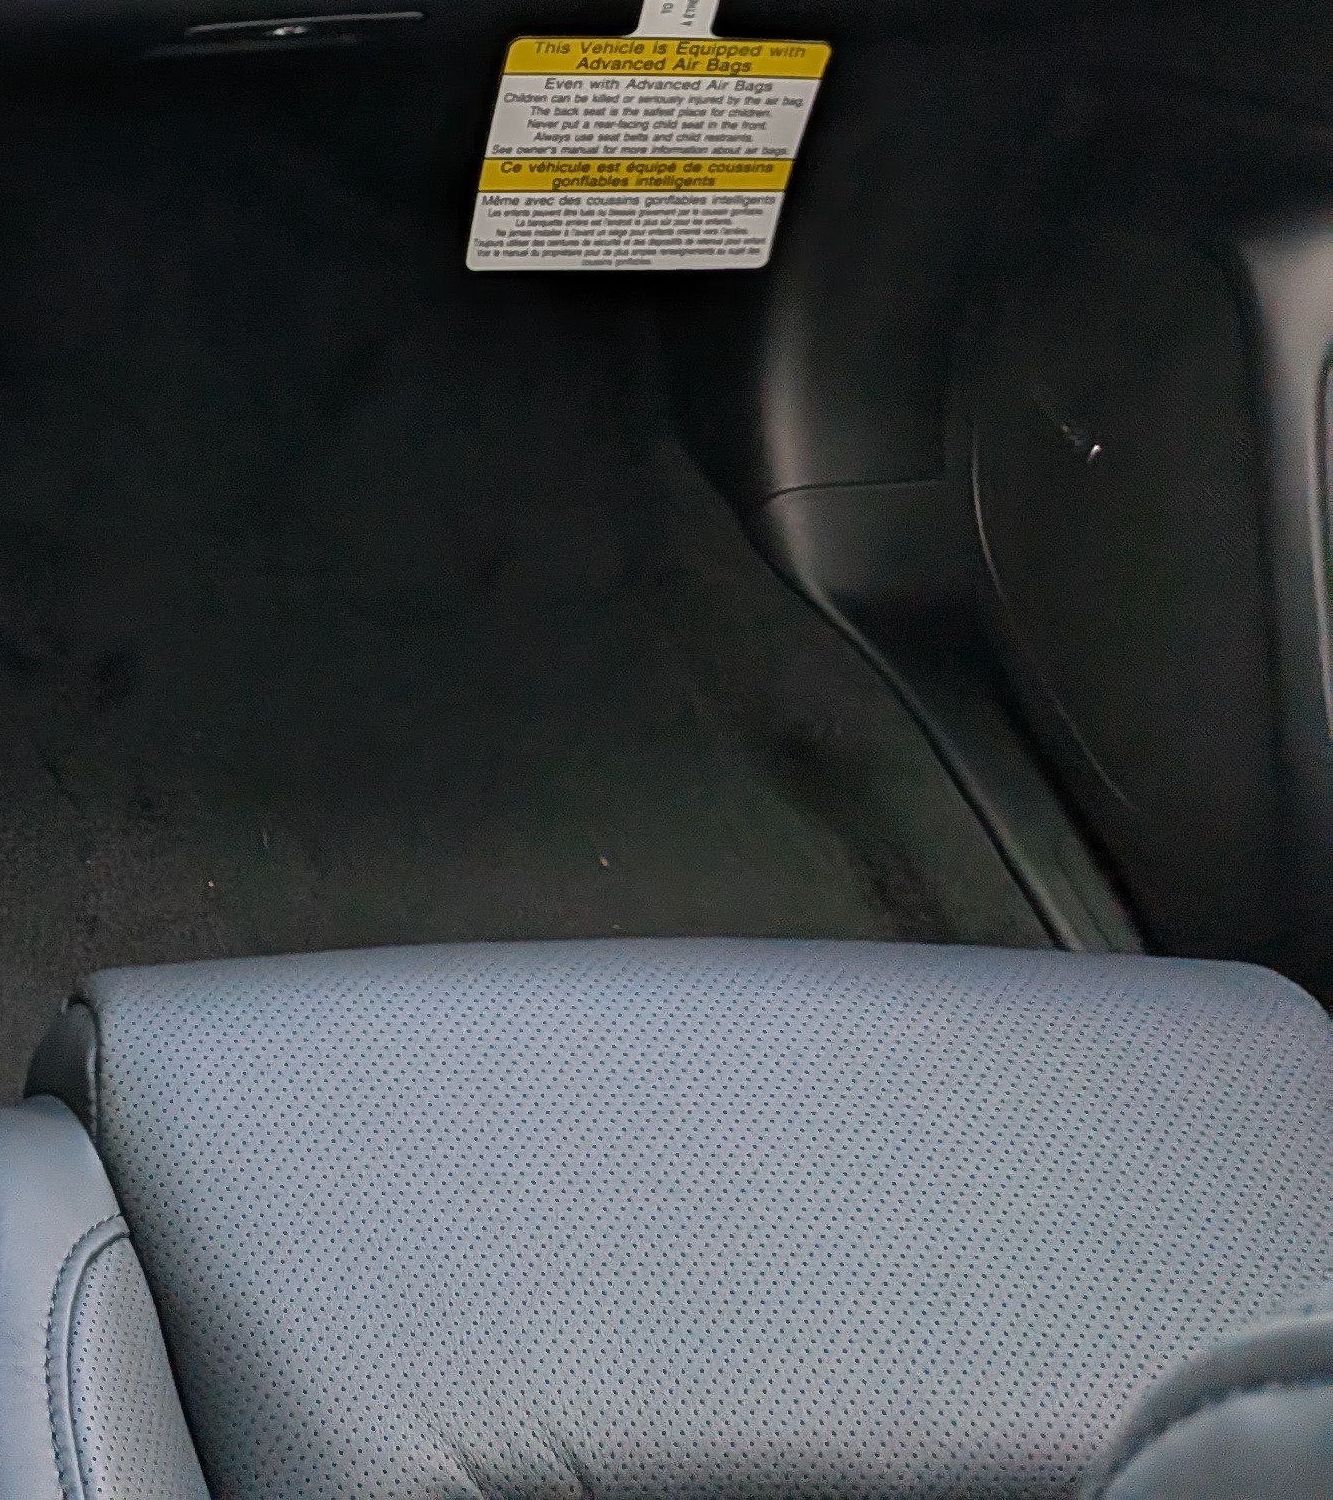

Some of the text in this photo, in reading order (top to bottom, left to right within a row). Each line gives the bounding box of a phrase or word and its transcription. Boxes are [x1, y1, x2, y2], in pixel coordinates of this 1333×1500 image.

[534, 41, 571, 54] This
[581, 41, 645, 55] Vehicle
[676, 40, 762, 58] Equipped
[770, 46, 806, 58] with
[575, 57, 752, 75] Advanced Air Bags
[544, 78, 773, 94] Even with Advanced Air Bags
[504, 93, 547, 103] Children
[551, 94, 570, 103] can
[575, 94, 588, 103] be
[592, 93, 620, 103] killed
[688, 95, 724, 105] injured
[727, 96, 740, 106] by
[744, 96, 761, 105] the
[530, 106, 551, 116] The
[554, 106, 579, 116] back
[583, 107, 606, 116] seat
[609, 107, 618, 116] is
[622, 107, 639, 116] the
[710, 108, 725, 116] for
[527, 119, 559, 129] Never
[562, 119, 579, 130] put
[582, 121, 590, 129] a
[594, 120, 649, 131] rear-facing
[652, 120, 678, 129] child
[681, 121, 704, 129] seat
[721, 121, 738, 129] the
[534, 132, 570, 143] Always
[575, 133, 593, 141] use
[598, 133, 620, 141] seat
[652, 133, 673, 141] and
[676, 133, 701, 142] child
[491, 144, 512, 154] See
[516, 146, 556, 154] owner's
[561, 145, 599, 154] manual
[603, 145, 618, 154] for
[620, 146, 647, 154] more
[500, 161, 773, 174] Ce véhicule est équipé de coussins
[552, 175, 715, 191] gonflables intelligents
[481, 195, 776, 207] Même avec des coussins gonflables intelligents
